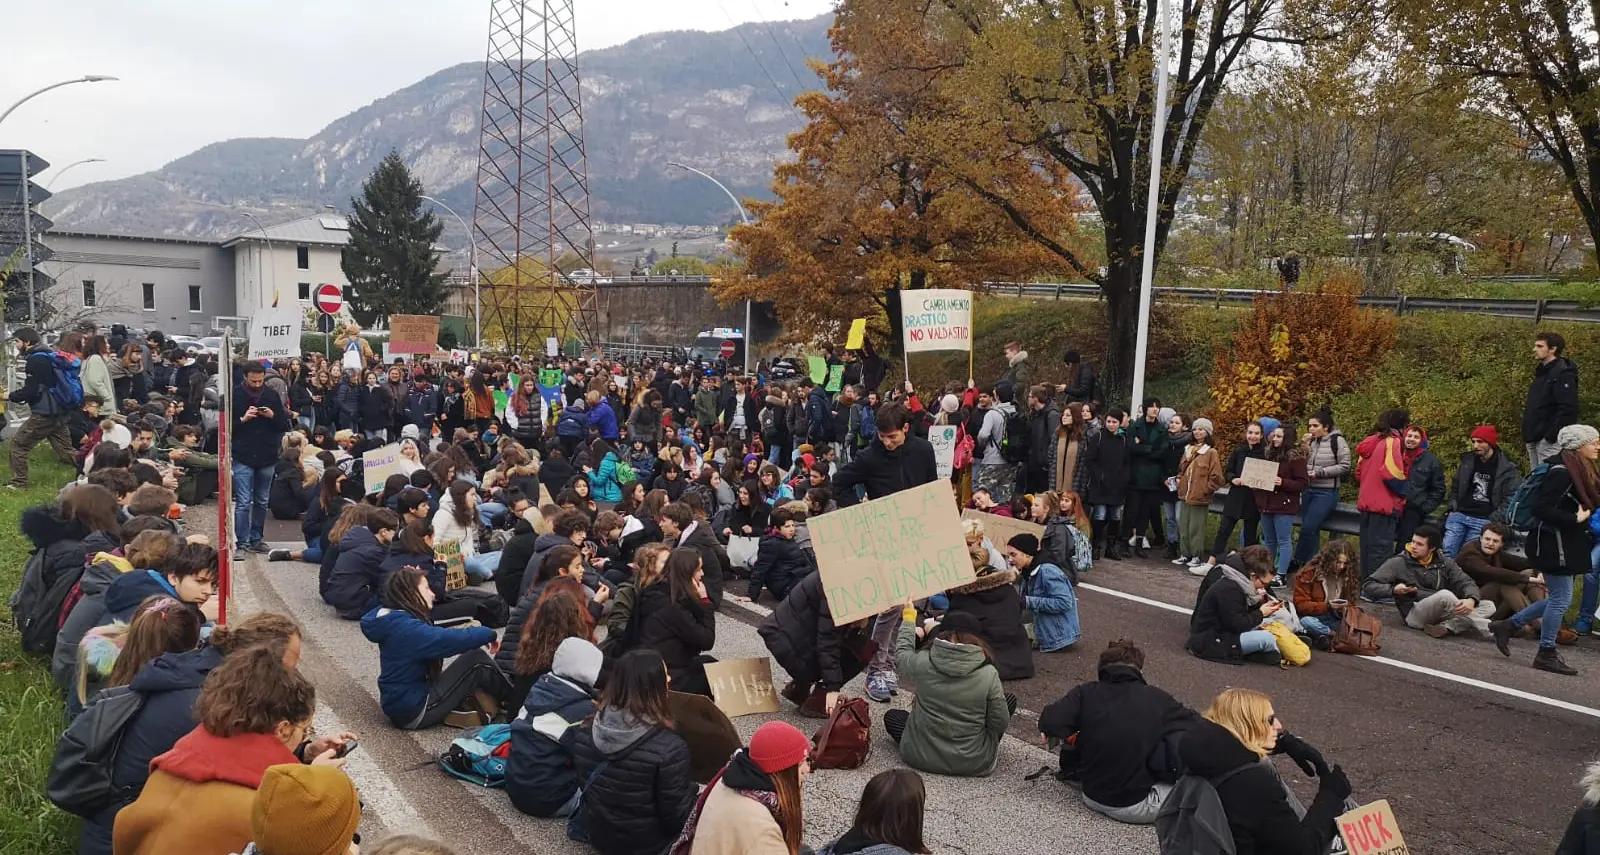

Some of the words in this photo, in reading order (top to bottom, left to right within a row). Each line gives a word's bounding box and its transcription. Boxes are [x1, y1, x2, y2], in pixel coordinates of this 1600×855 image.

[923, 299, 969, 311] CAMBIAMENTO
[904, 313, 947, 328] DRASTICO
[263, 325, 291, 337] TIBET
[910, 329, 924, 342] NO
[826, 545, 969, 619] INQUINARE
[1343, 810, 1393, 855] FUCK
